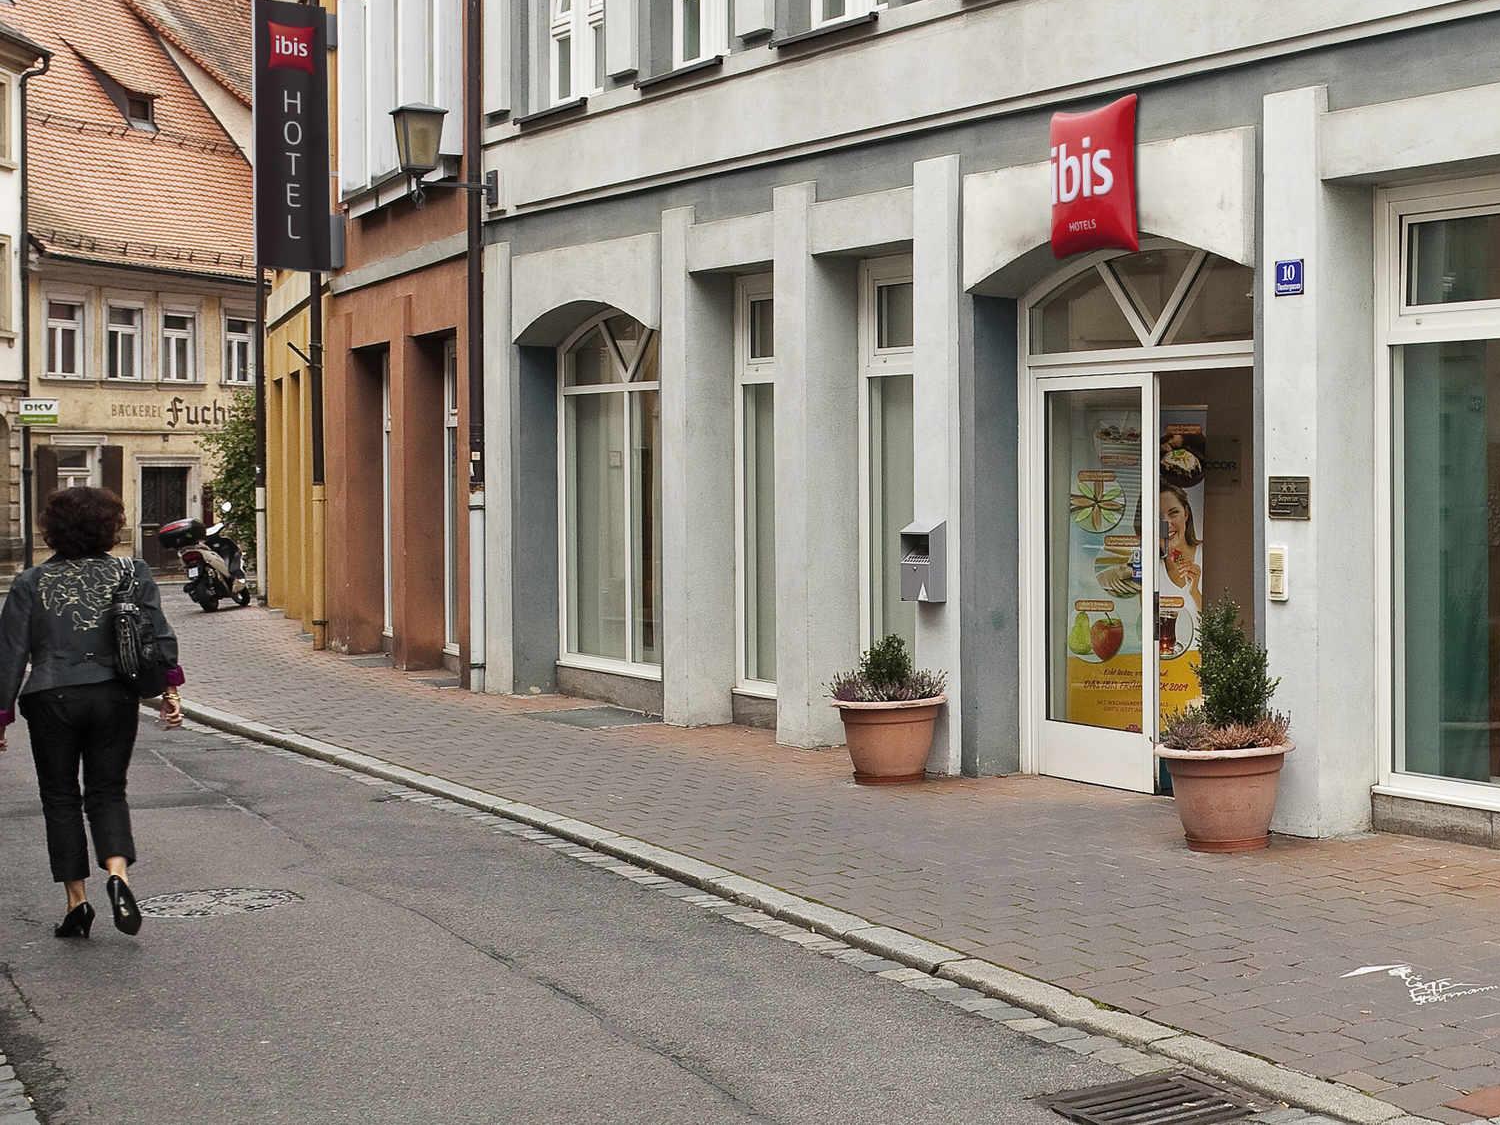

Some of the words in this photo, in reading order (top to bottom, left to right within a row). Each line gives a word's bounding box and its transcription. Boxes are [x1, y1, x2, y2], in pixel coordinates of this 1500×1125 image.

[274, 35, 309, 58] ibis
[283, 90, 303, 240] HOTEL
[1050, 136, 1114, 206] ibis
[1068, 218, 1097, 233] HOTELS
[1281, 264, 1296, 282] 10
[24, 403, 54, 412] DKV
